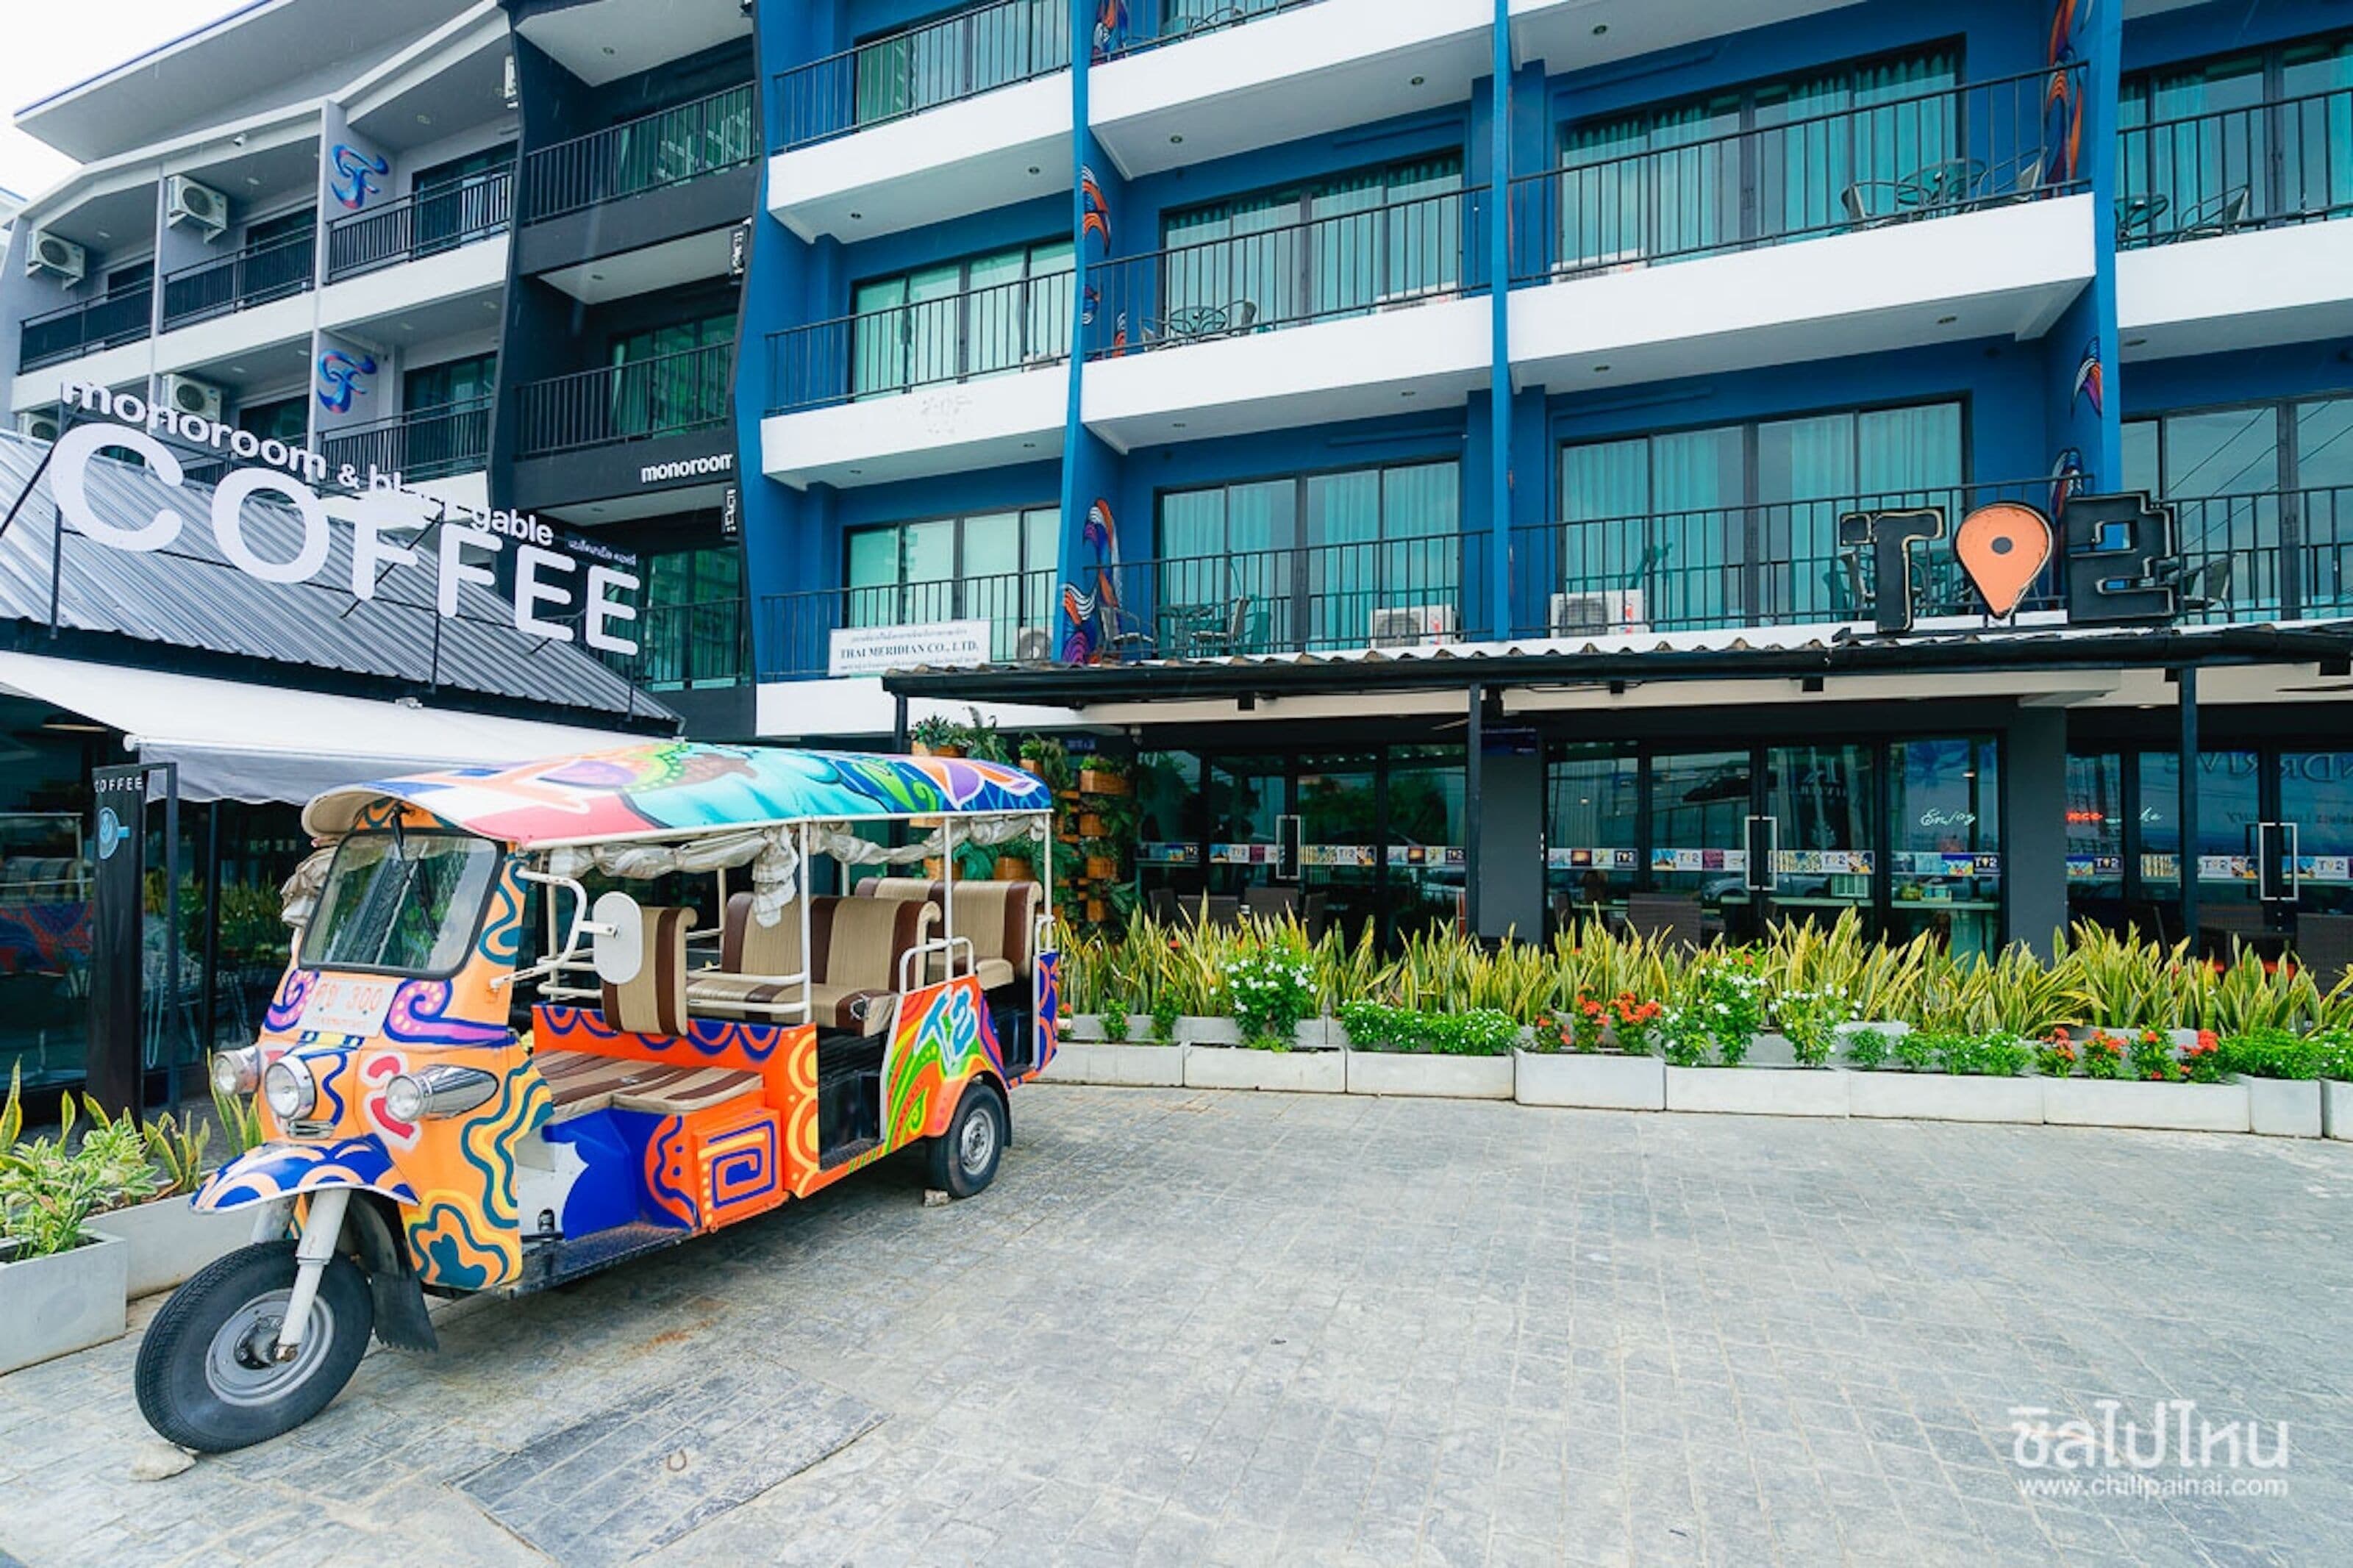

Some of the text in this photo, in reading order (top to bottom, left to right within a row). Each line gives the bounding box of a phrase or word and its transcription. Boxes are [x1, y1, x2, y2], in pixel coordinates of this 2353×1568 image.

[62, 381, 328, 480] monoroom
[338, 463, 360, 489] &
[50, 423, 640, 655] COFFEE
[870, 642, 924, 657] MERIDIAN
[94, 776, 143, 792] COFFEE
